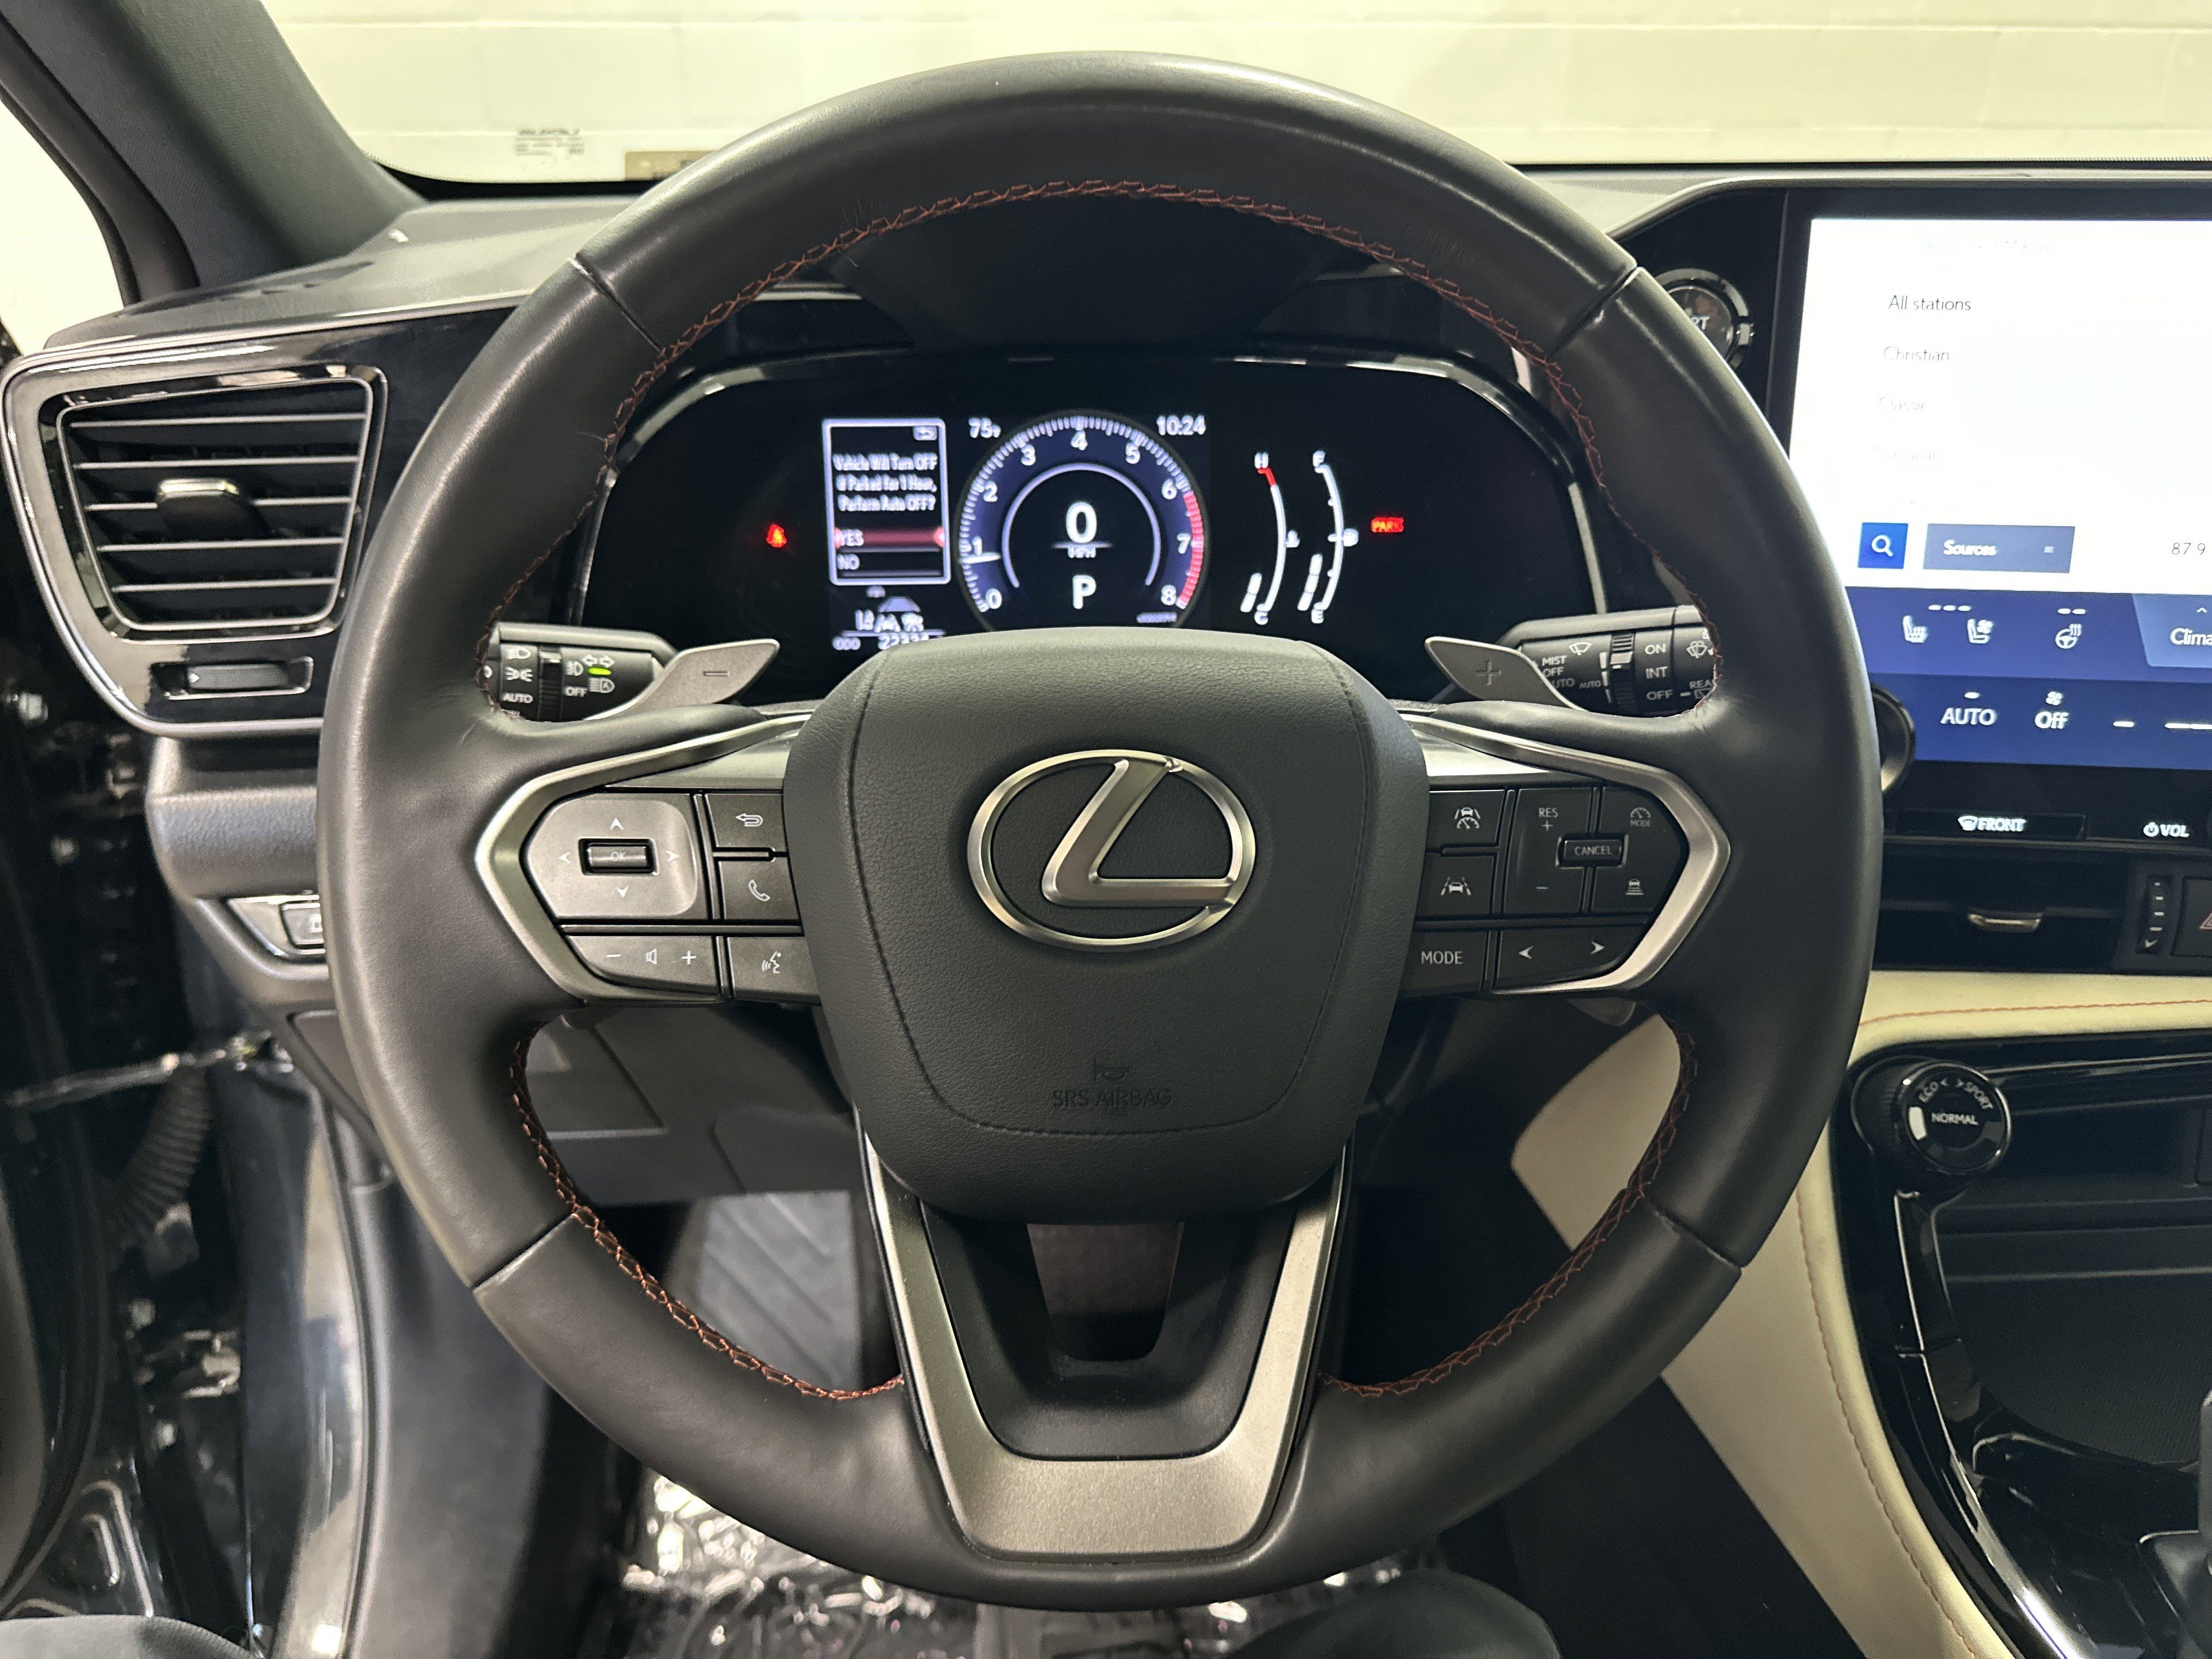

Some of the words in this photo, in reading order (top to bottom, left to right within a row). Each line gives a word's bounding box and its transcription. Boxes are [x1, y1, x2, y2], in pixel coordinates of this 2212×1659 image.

[1888, 295, 1908, 310] All
[1913, 297, 1971, 311] stations
[1883, 346, 1949, 362] Christian
[1156, 415, 1206, 435] 10:24
[1070, 431, 1088, 450] 4
[913, 453, 938, 470] OFF
[1021, 444, 1036, 466] 3
[1125, 444, 1141, 465] 5
[983, 479, 998, 502] 2
[1161, 481, 1177, 500] 6
[1066, 501, 1097, 543] 0
[839, 529, 864, 546] YES
[1177, 533, 1191, 554] 7
[972, 538, 983, 555] 1
[1943, 539, 1998, 557] Sources
[2172, 542, 2206, 556] 879
[837, 554, 860, 570] NO
[986, 589, 1001, 610] 0
[1073, 574, 1096, 609] P
[1161, 584, 1176, 605] 8
[1645, 644, 1666, 654] ON
[1542, 654, 1567, 666] MIST
[1543, 667, 1564, 678] OFF
[1645, 665, 1668, 679] INT
[565, 686, 588, 697] OFF
[1550, 678, 1575, 689] UTO
[1578, 680, 1601, 689] AUTO
[1689, 679, 1716, 689] REA
[501, 692, 533, 704] AUTO
[1646, 690, 1673, 701] OFF
[1940, 708, 1997, 726] AUTO
[2034, 712, 2069, 729] Off
[1538, 807, 1559, 818] RES
[1977, 818, 2027, 832] FRONT
[2160, 825, 2190, 838] VOL
[611, 851, 626, 861] OK
[1574, 845, 1613, 856] CANCEL
[1421, 950, 1463, 964] MODE
[1052, 1088, 1090, 1107] SRS
[1096, 1088, 1173, 1108] AIRBAG
[1918, 1081, 1939, 1103] ECO
[1963, 1081, 1993, 1109] SPORT
[1931, 1113, 1978, 1126] NORMAL
